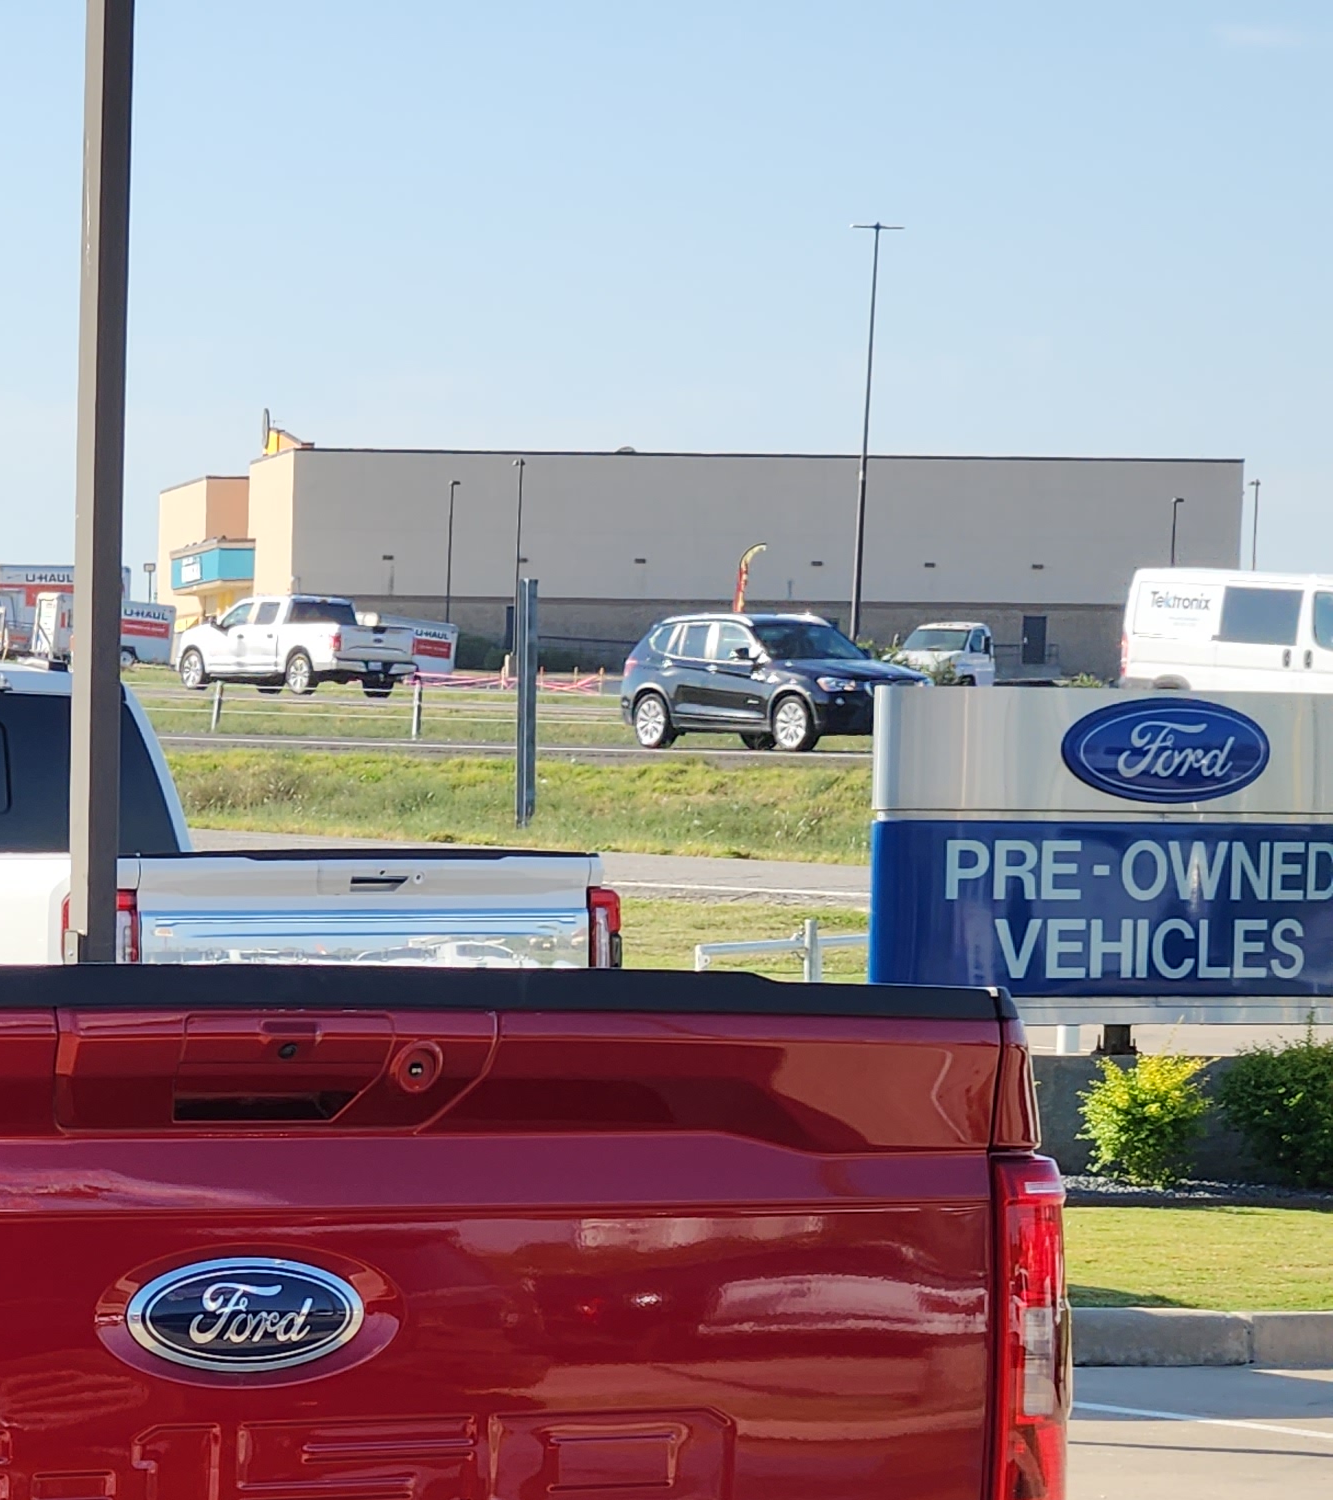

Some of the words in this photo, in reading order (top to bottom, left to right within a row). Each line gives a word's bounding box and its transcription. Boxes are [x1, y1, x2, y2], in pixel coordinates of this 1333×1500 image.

[1150, 590, 1211, 611] Tektronix
[1117, 721, 1235, 780] Ford
[994, 917, 1305, 980] VEHICLES
[189, 1282, 313, 1344] Ford
